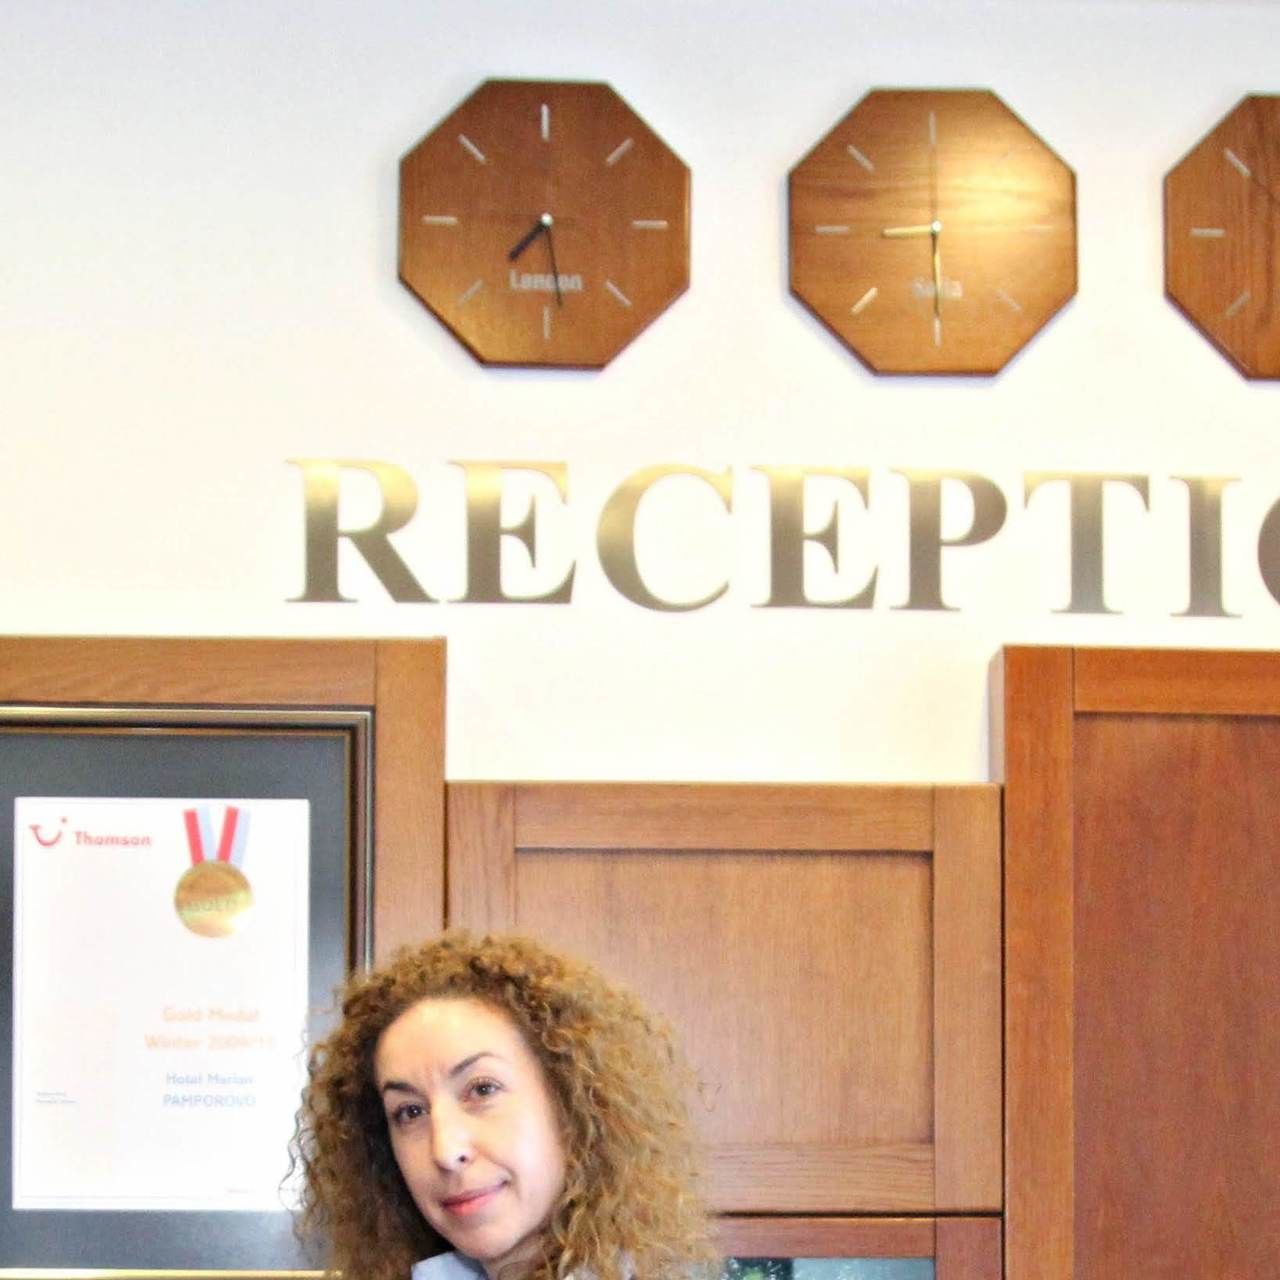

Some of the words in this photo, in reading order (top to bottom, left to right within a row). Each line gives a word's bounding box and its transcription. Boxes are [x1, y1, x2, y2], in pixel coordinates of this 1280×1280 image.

[912, 276, 963, 299] Soia
[74, 831, 152, 846] Thomson
[163, 1094, 256, 1108] PAMPOROVO
